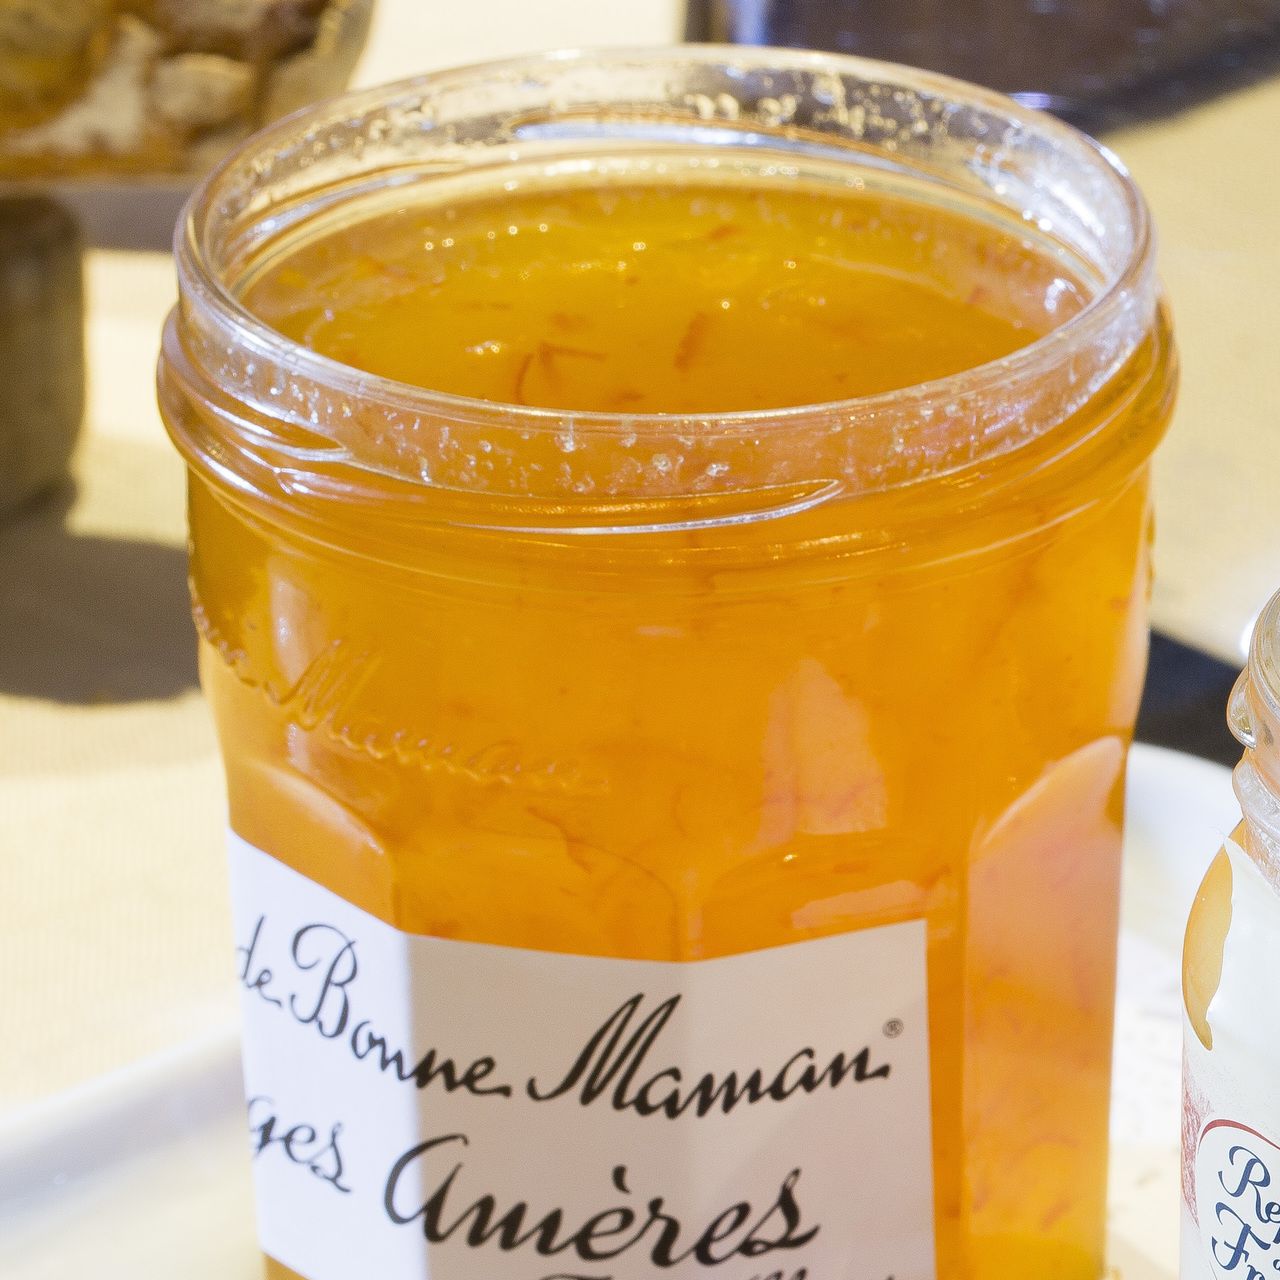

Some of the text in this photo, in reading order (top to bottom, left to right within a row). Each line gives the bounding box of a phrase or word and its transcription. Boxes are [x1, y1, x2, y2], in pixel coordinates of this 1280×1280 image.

[289, 923, 513, 1098] Bonne
[526, 992, 893, 1121] Maman
[384, 1131, 820, 1268] Amères
